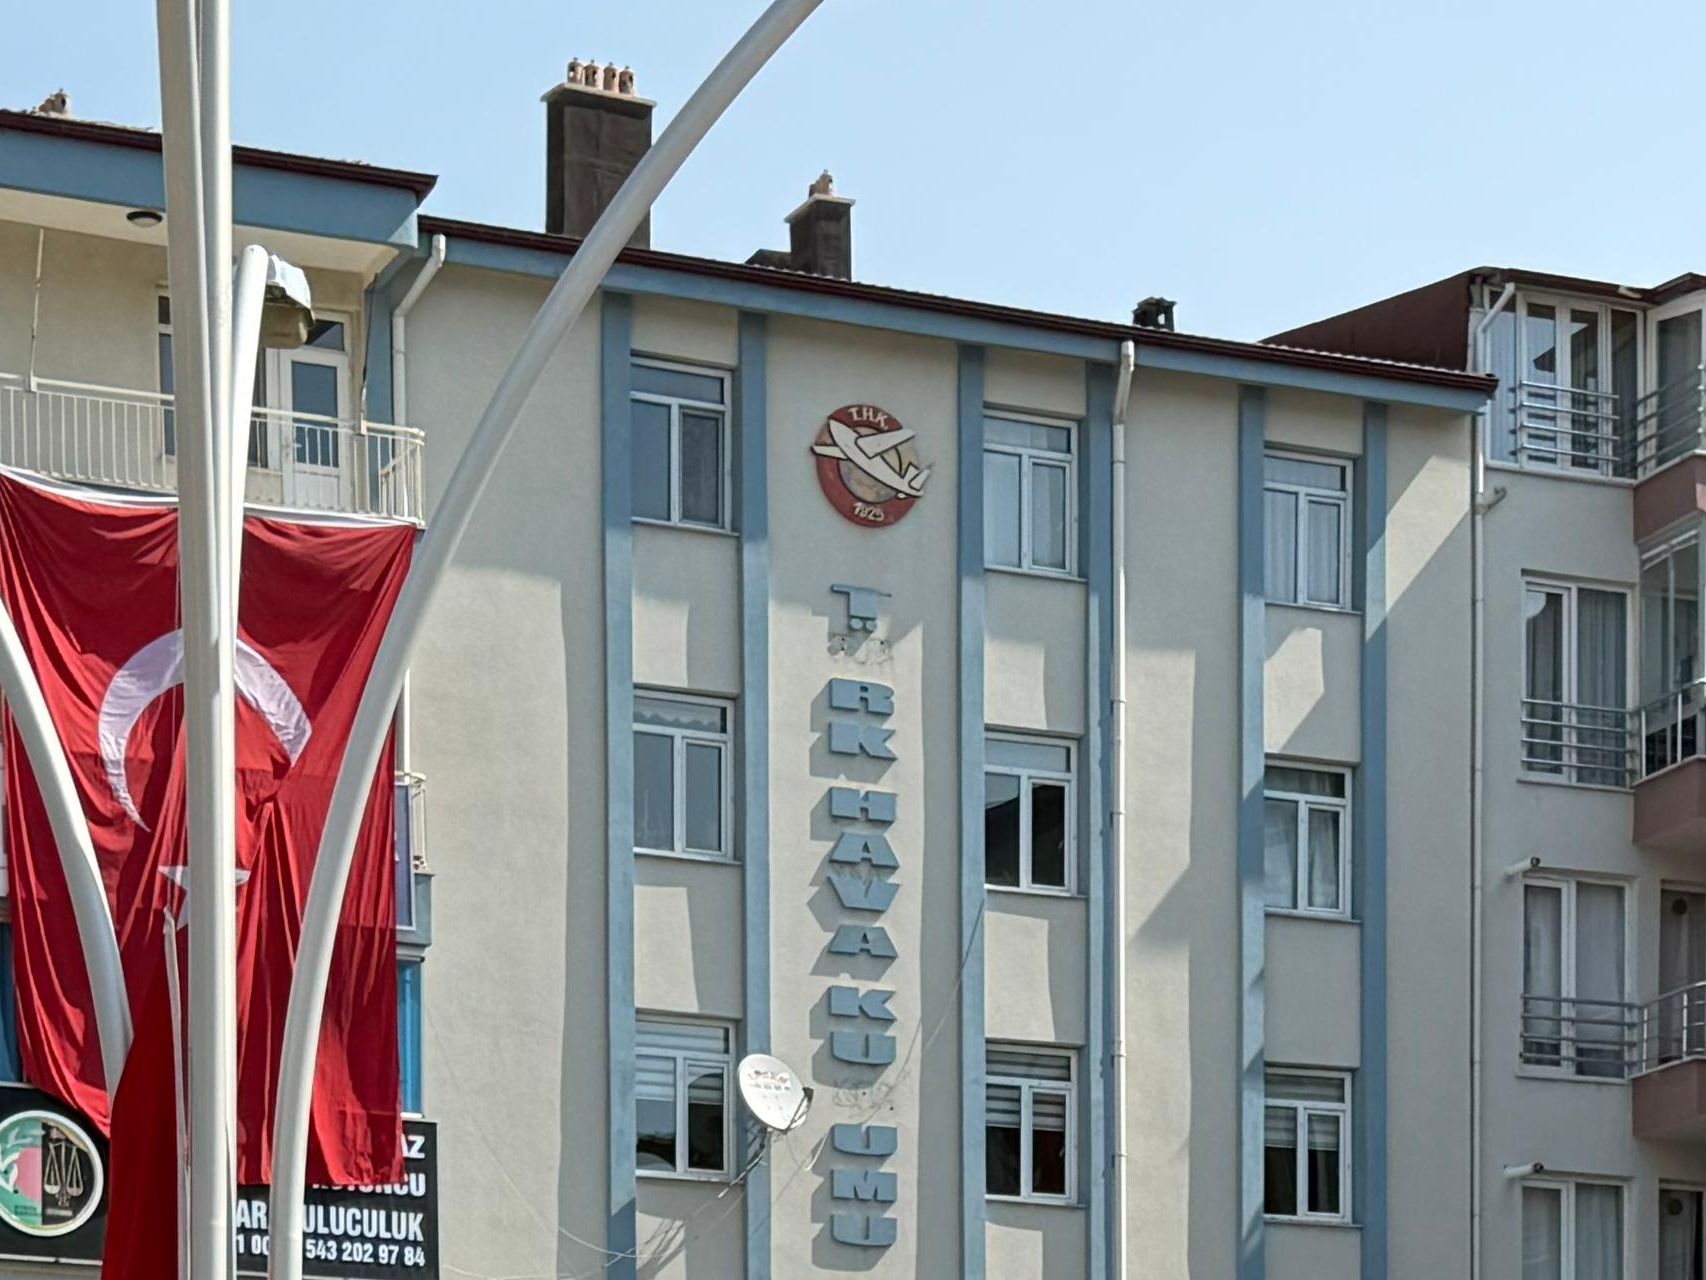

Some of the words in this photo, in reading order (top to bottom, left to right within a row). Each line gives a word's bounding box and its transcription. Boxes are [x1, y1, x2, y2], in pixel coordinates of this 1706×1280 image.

[342, 1241, 374, 1263] 202
[379, 1244, 399, 1264] 97
[404, 1247, 426, 1267] 84
